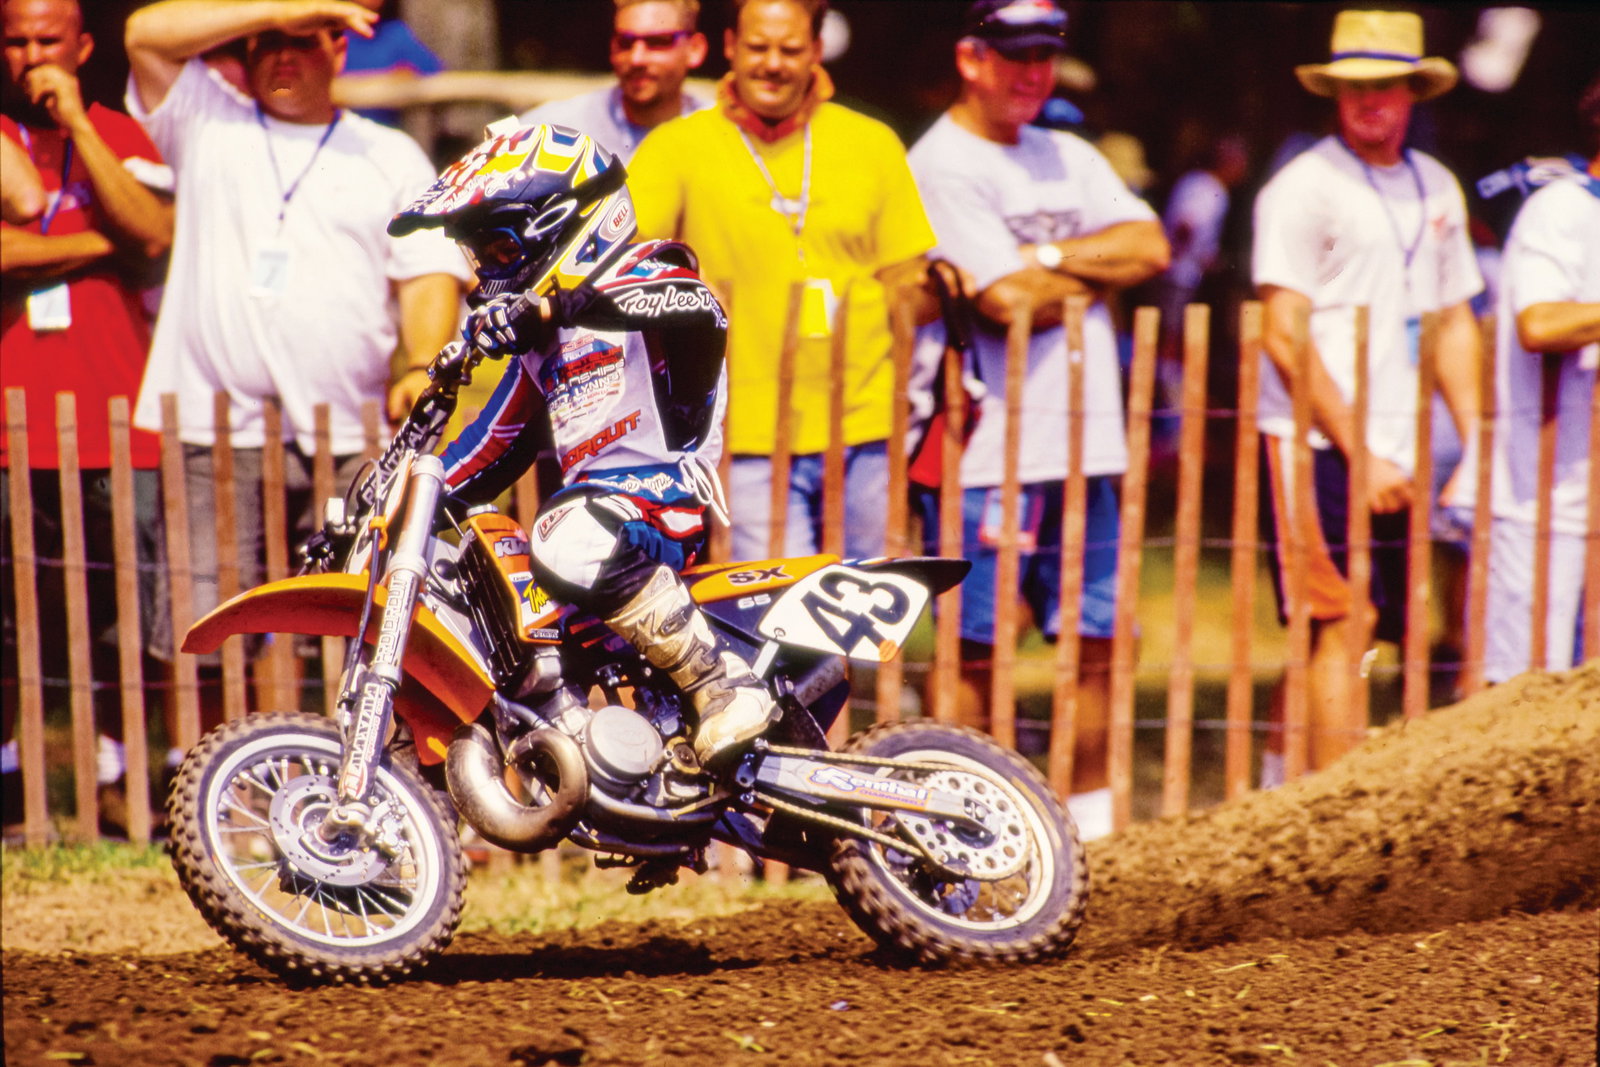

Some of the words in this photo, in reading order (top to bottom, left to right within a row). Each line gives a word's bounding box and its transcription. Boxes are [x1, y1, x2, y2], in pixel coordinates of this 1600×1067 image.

[613, 205, 629, 228] BELL
[727, 566, 792, 585] SX
[738, 594, 771, 609] 65
[800, 571, 910, 655] 43
[350, 684, 379, 770] MAXIMA
[810, 767, 928, 801] Renthal
